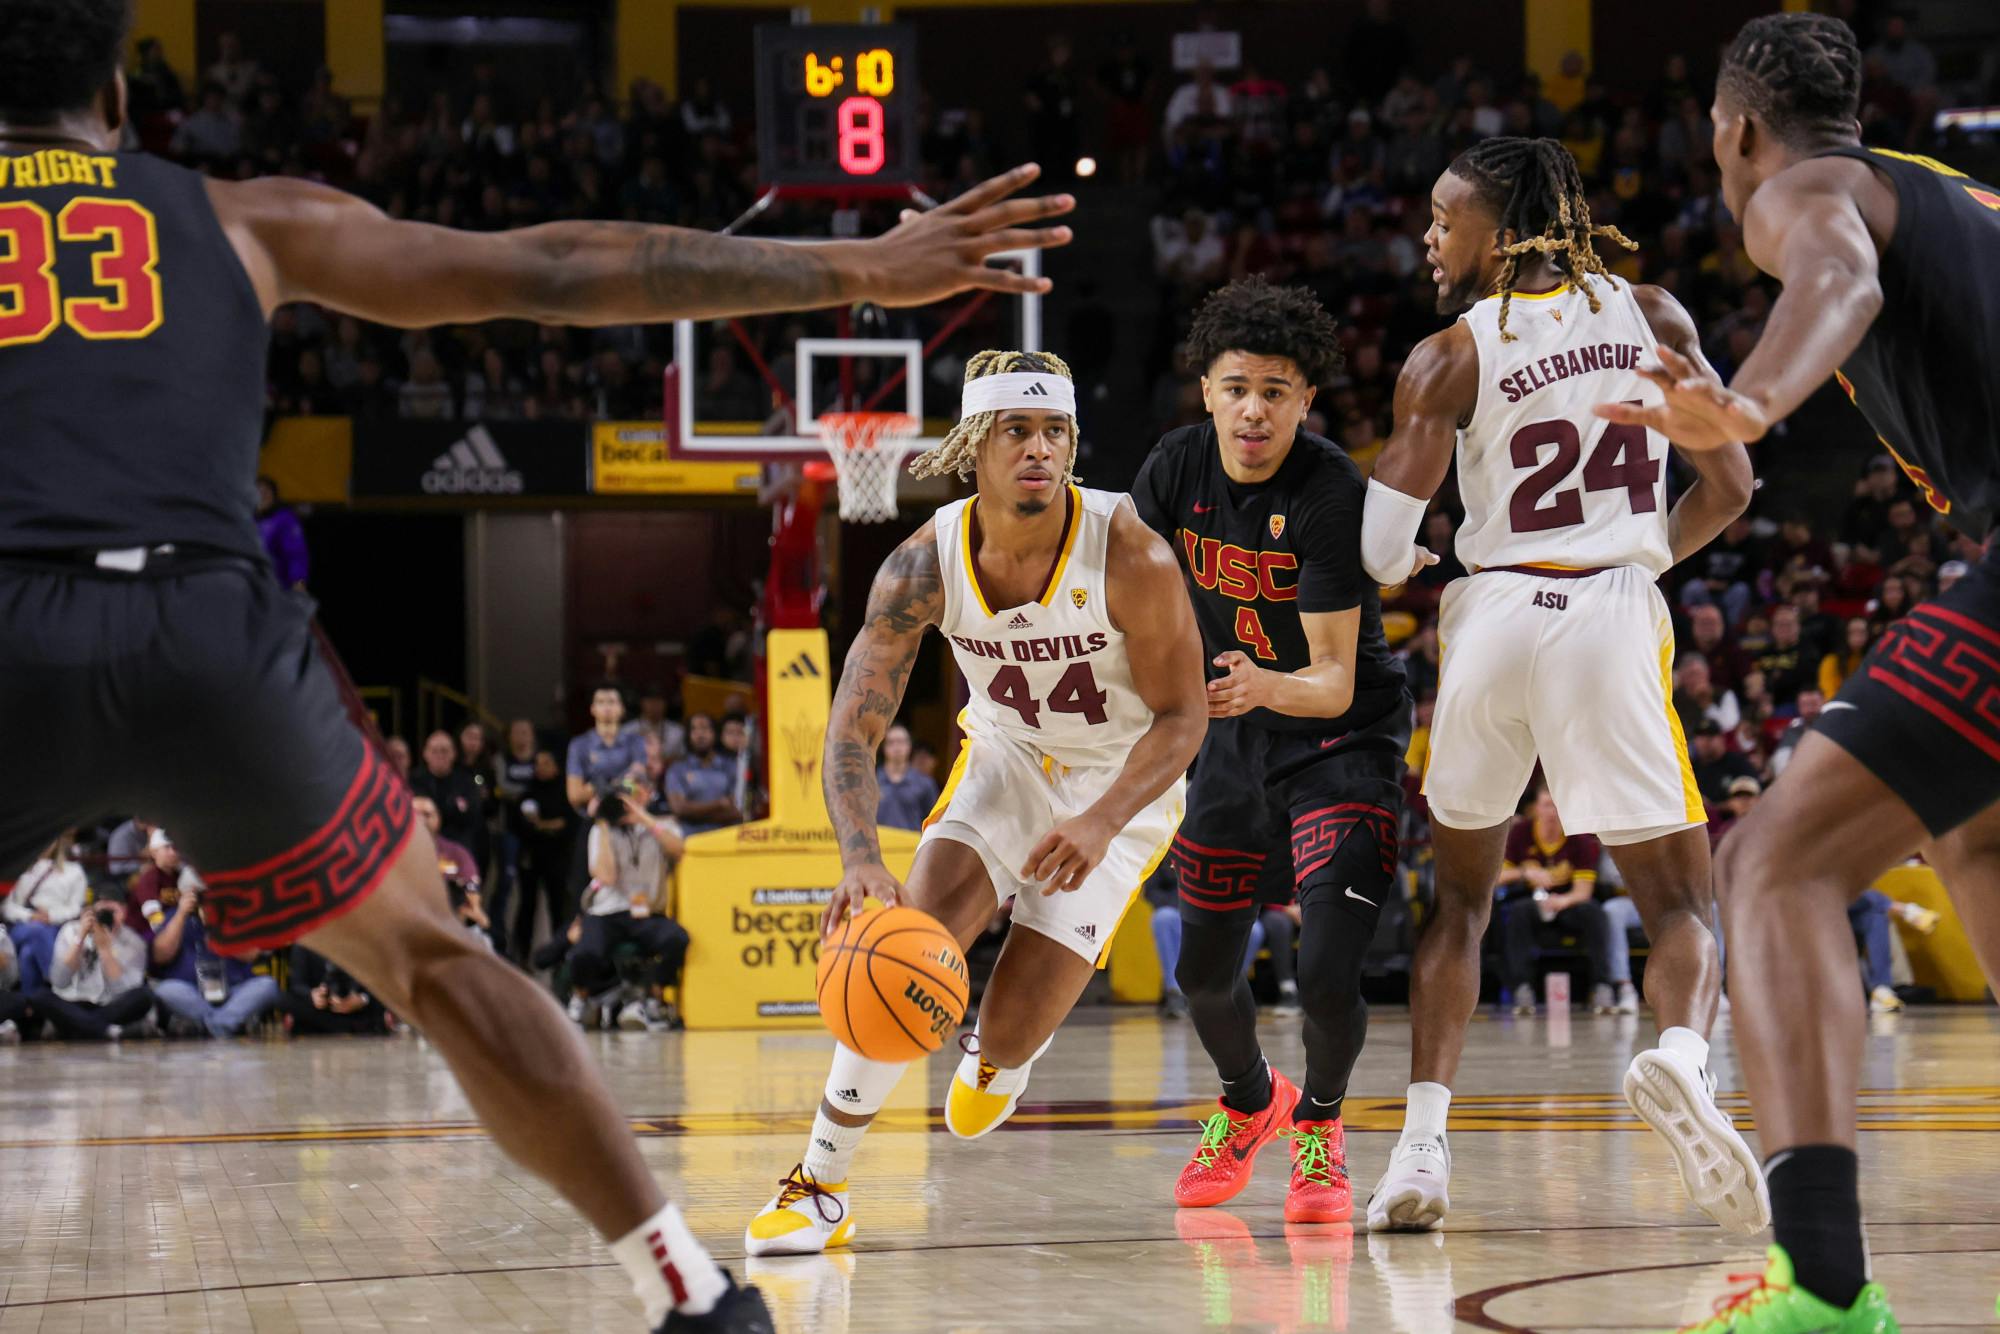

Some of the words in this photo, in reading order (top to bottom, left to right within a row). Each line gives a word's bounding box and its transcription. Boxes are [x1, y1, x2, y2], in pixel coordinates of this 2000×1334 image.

[838, 96, 885, 175] 8
[1499, 343, 1643, 403] SELEBANGUE
[420, 464, 523, 494] adidas
[1509, 399, 1660, 533] 24
[1183, 527, 1298, 602] USC
[1007, 622, 1034, 630] adidas
[1532, 590, 1568, 611] ASU
[951, 634, 1006, 660] SUN
[1010, 632, 1108, 662] DEVILS
[1235, 606, 1277, 660] 4
[987, 661, 1109, 729] 44
[742, 939, 775, 968] of
